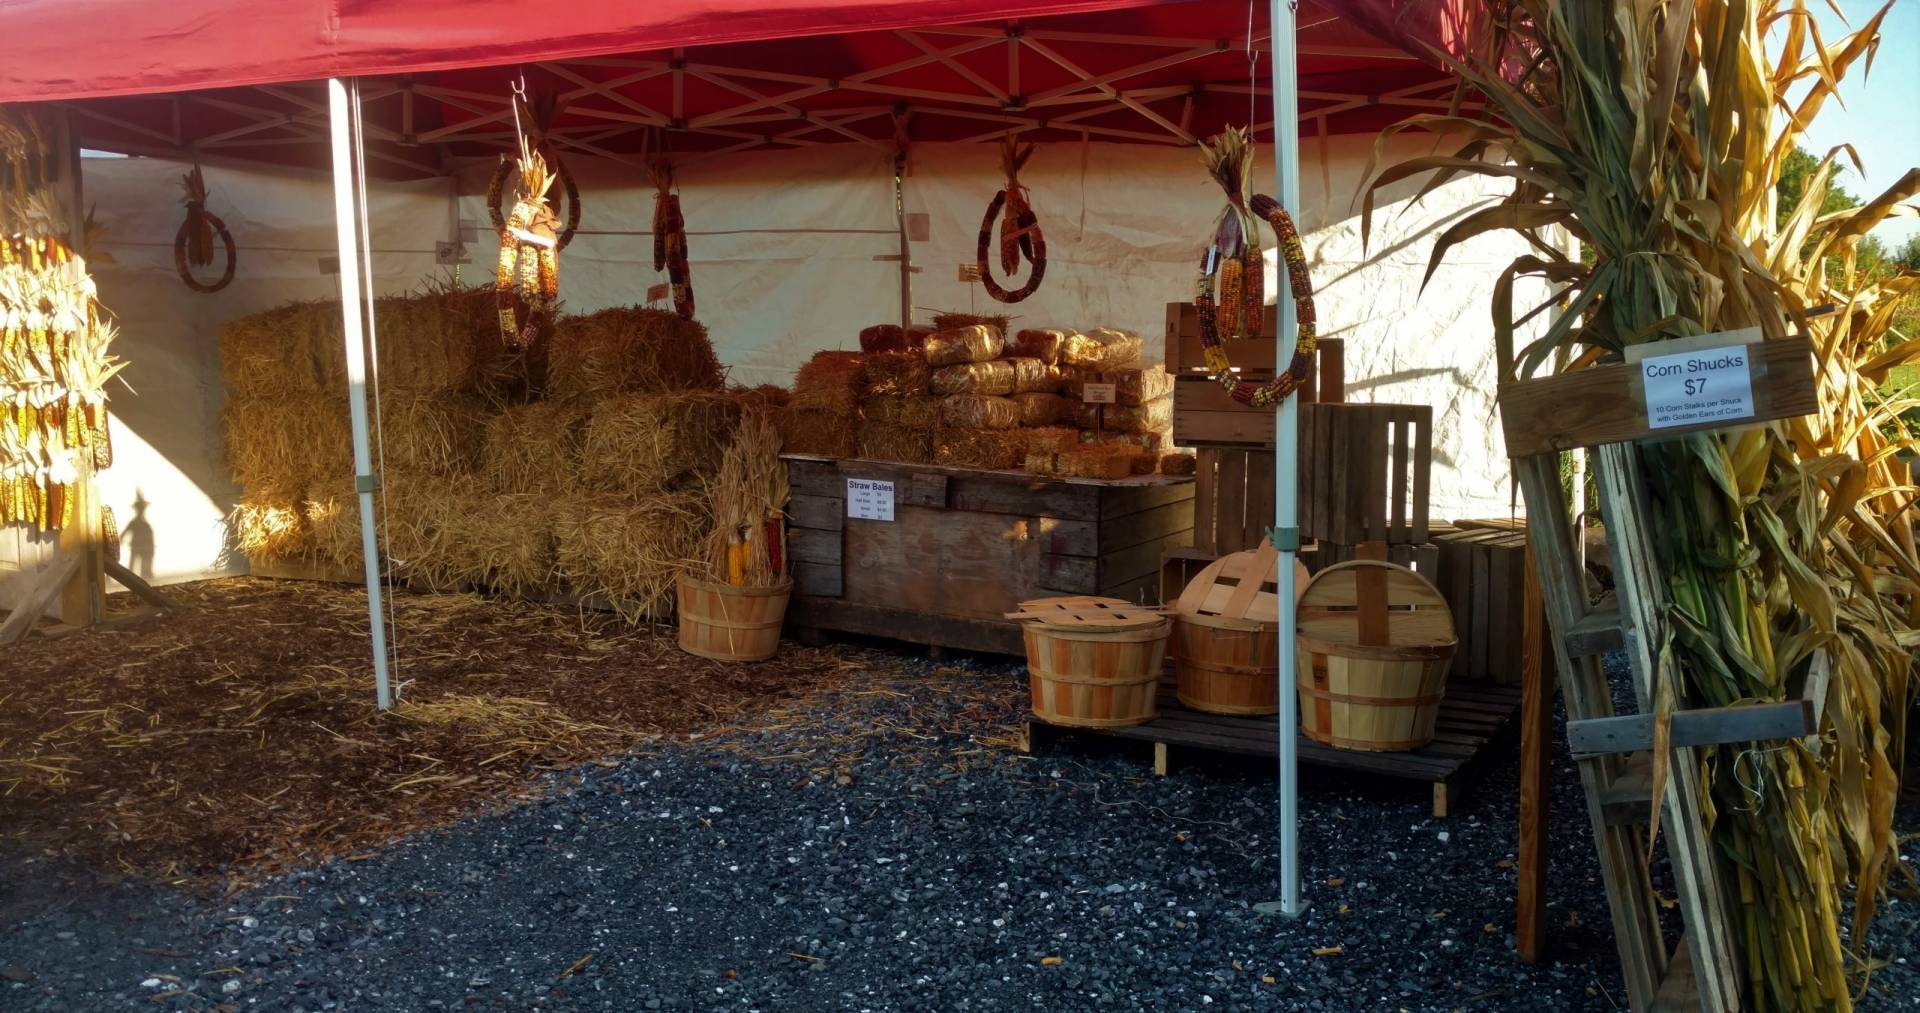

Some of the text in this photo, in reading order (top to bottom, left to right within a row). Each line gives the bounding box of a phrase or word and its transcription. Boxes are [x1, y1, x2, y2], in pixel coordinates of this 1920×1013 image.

[1646, 355, 1743, 378] Corn Shucks
[1684, 378, 1707, 396] $7
[1684, 402, 1705, 410] Stalks
[1707, 401, 1718, 409] per
[1672, 413, 1697, 421] Golden
[1699, 410, 1715, 418] Ears
[1717, 408, 1724, 416] of
[1725, 407, 1743, 415] Corn
[849, 481, 893, 492] Straw Bales
